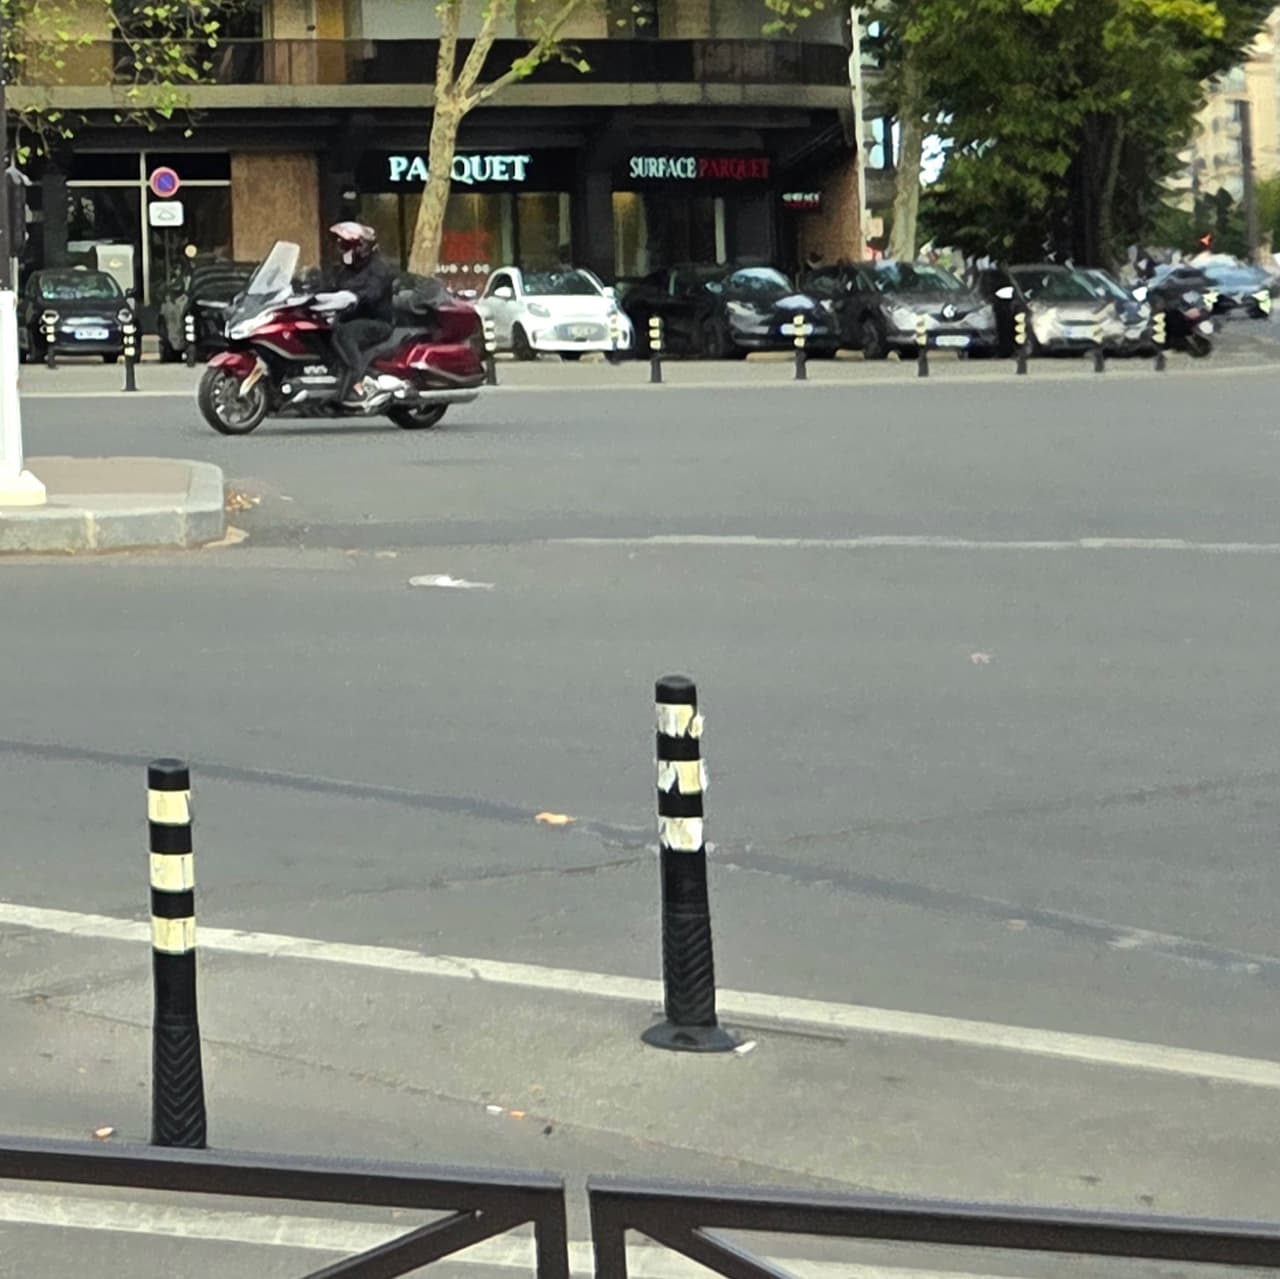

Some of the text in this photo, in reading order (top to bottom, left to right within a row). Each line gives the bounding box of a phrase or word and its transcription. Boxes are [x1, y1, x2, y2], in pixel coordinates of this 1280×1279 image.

[388, 155, 530, 185] PAQUET
[629, 156, 770, 180] SURFACE PARQUET
